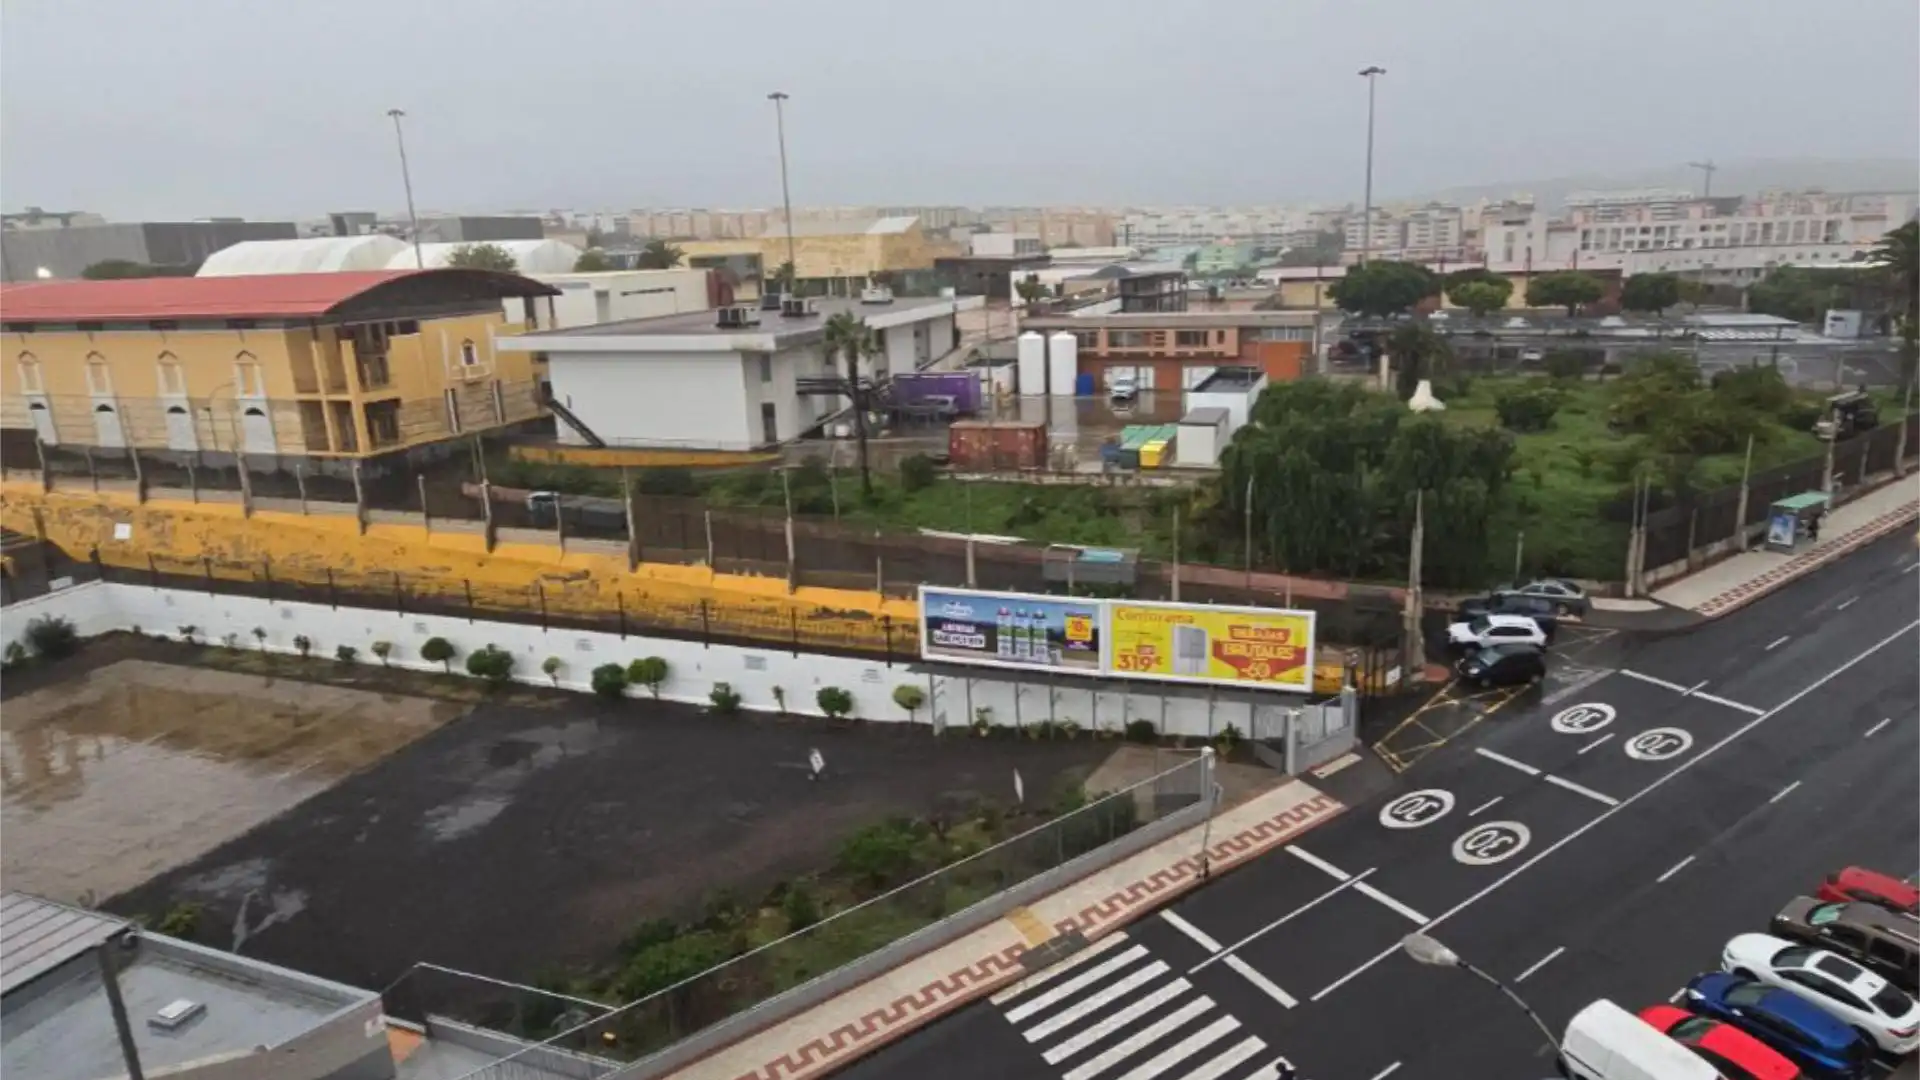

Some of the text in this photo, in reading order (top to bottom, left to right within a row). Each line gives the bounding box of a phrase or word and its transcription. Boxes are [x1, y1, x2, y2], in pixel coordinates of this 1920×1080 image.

[1562, 707, 1602, 729] 30
[1641, 732, 1680, 755] 30
[1390, 795, 1440, 822] 30
[1464, 829, 1514, 857] 30
